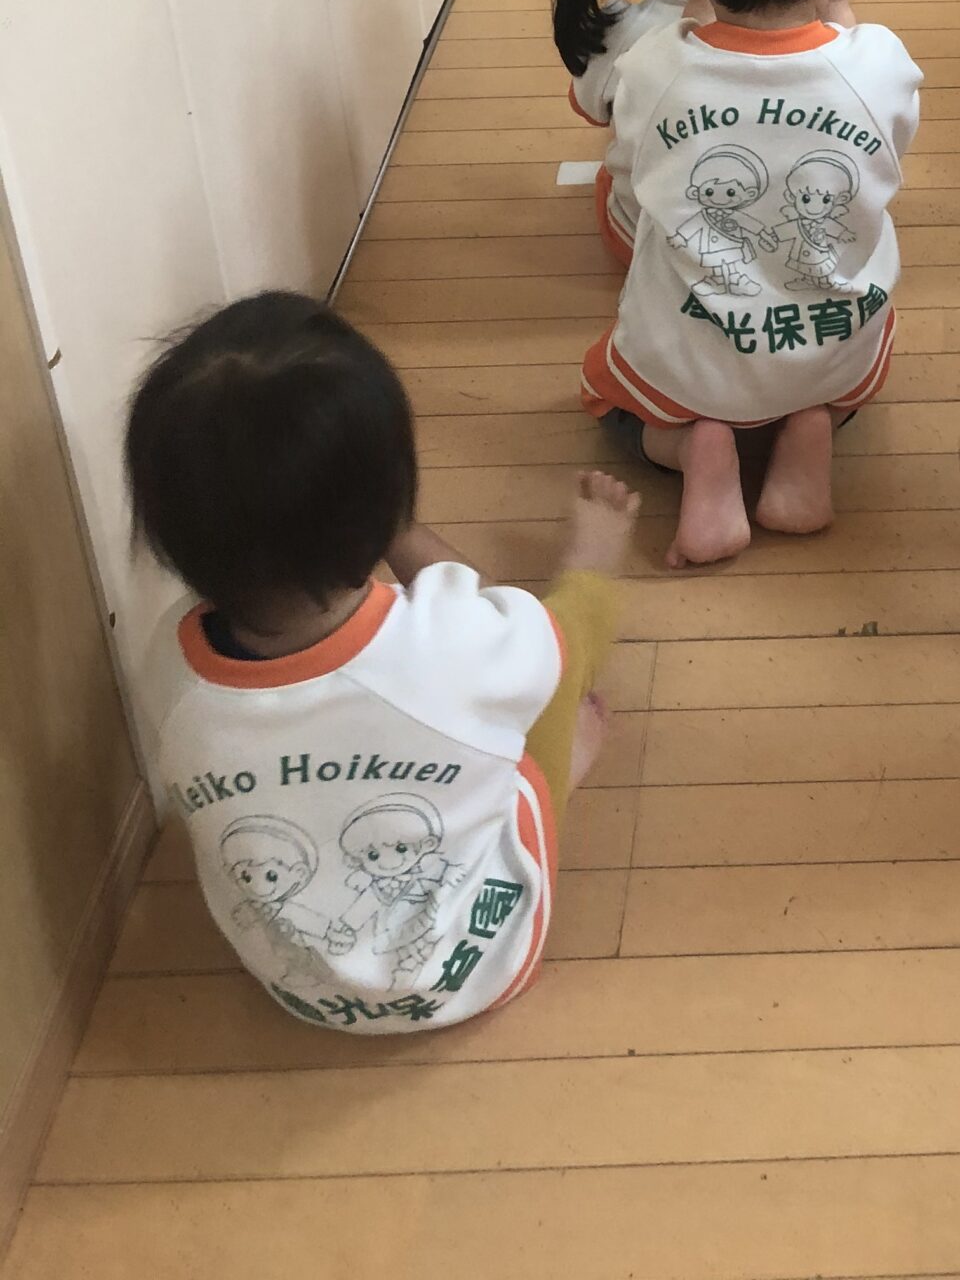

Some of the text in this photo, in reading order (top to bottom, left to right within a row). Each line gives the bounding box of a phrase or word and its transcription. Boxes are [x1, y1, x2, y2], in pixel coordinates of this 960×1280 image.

[656, 98, 882, 156] Keiko Hoikuen
[280, 753, 461, 786] Hoikuen
